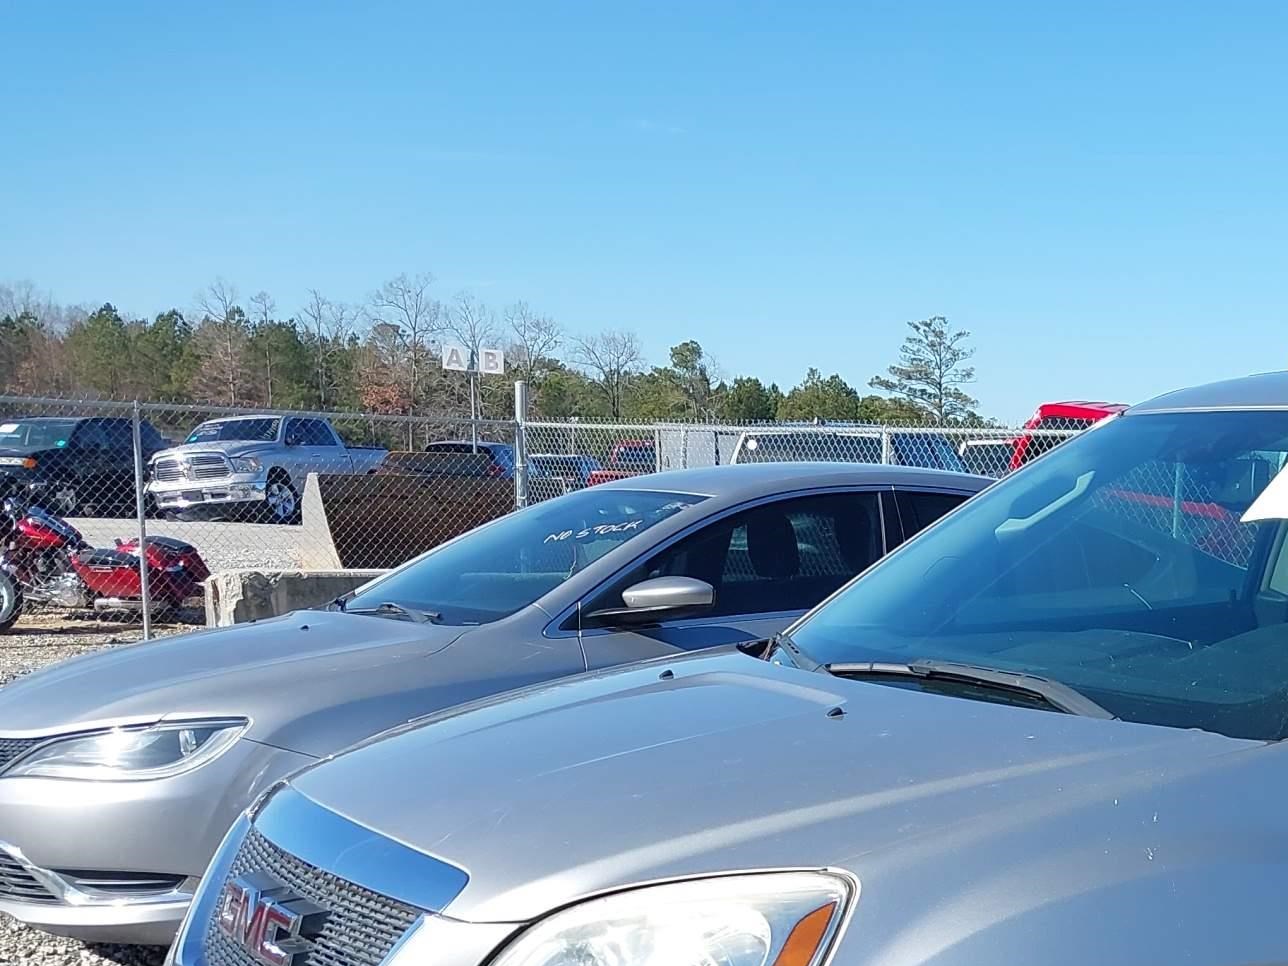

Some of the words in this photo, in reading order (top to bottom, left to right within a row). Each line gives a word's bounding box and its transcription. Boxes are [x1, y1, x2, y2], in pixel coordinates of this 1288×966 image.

[446, 348, 465, 369] A
[484, 351, 499, 371] B
[543, 529, 573, 544] NO
[575, 519, 644, 539] STOCK
